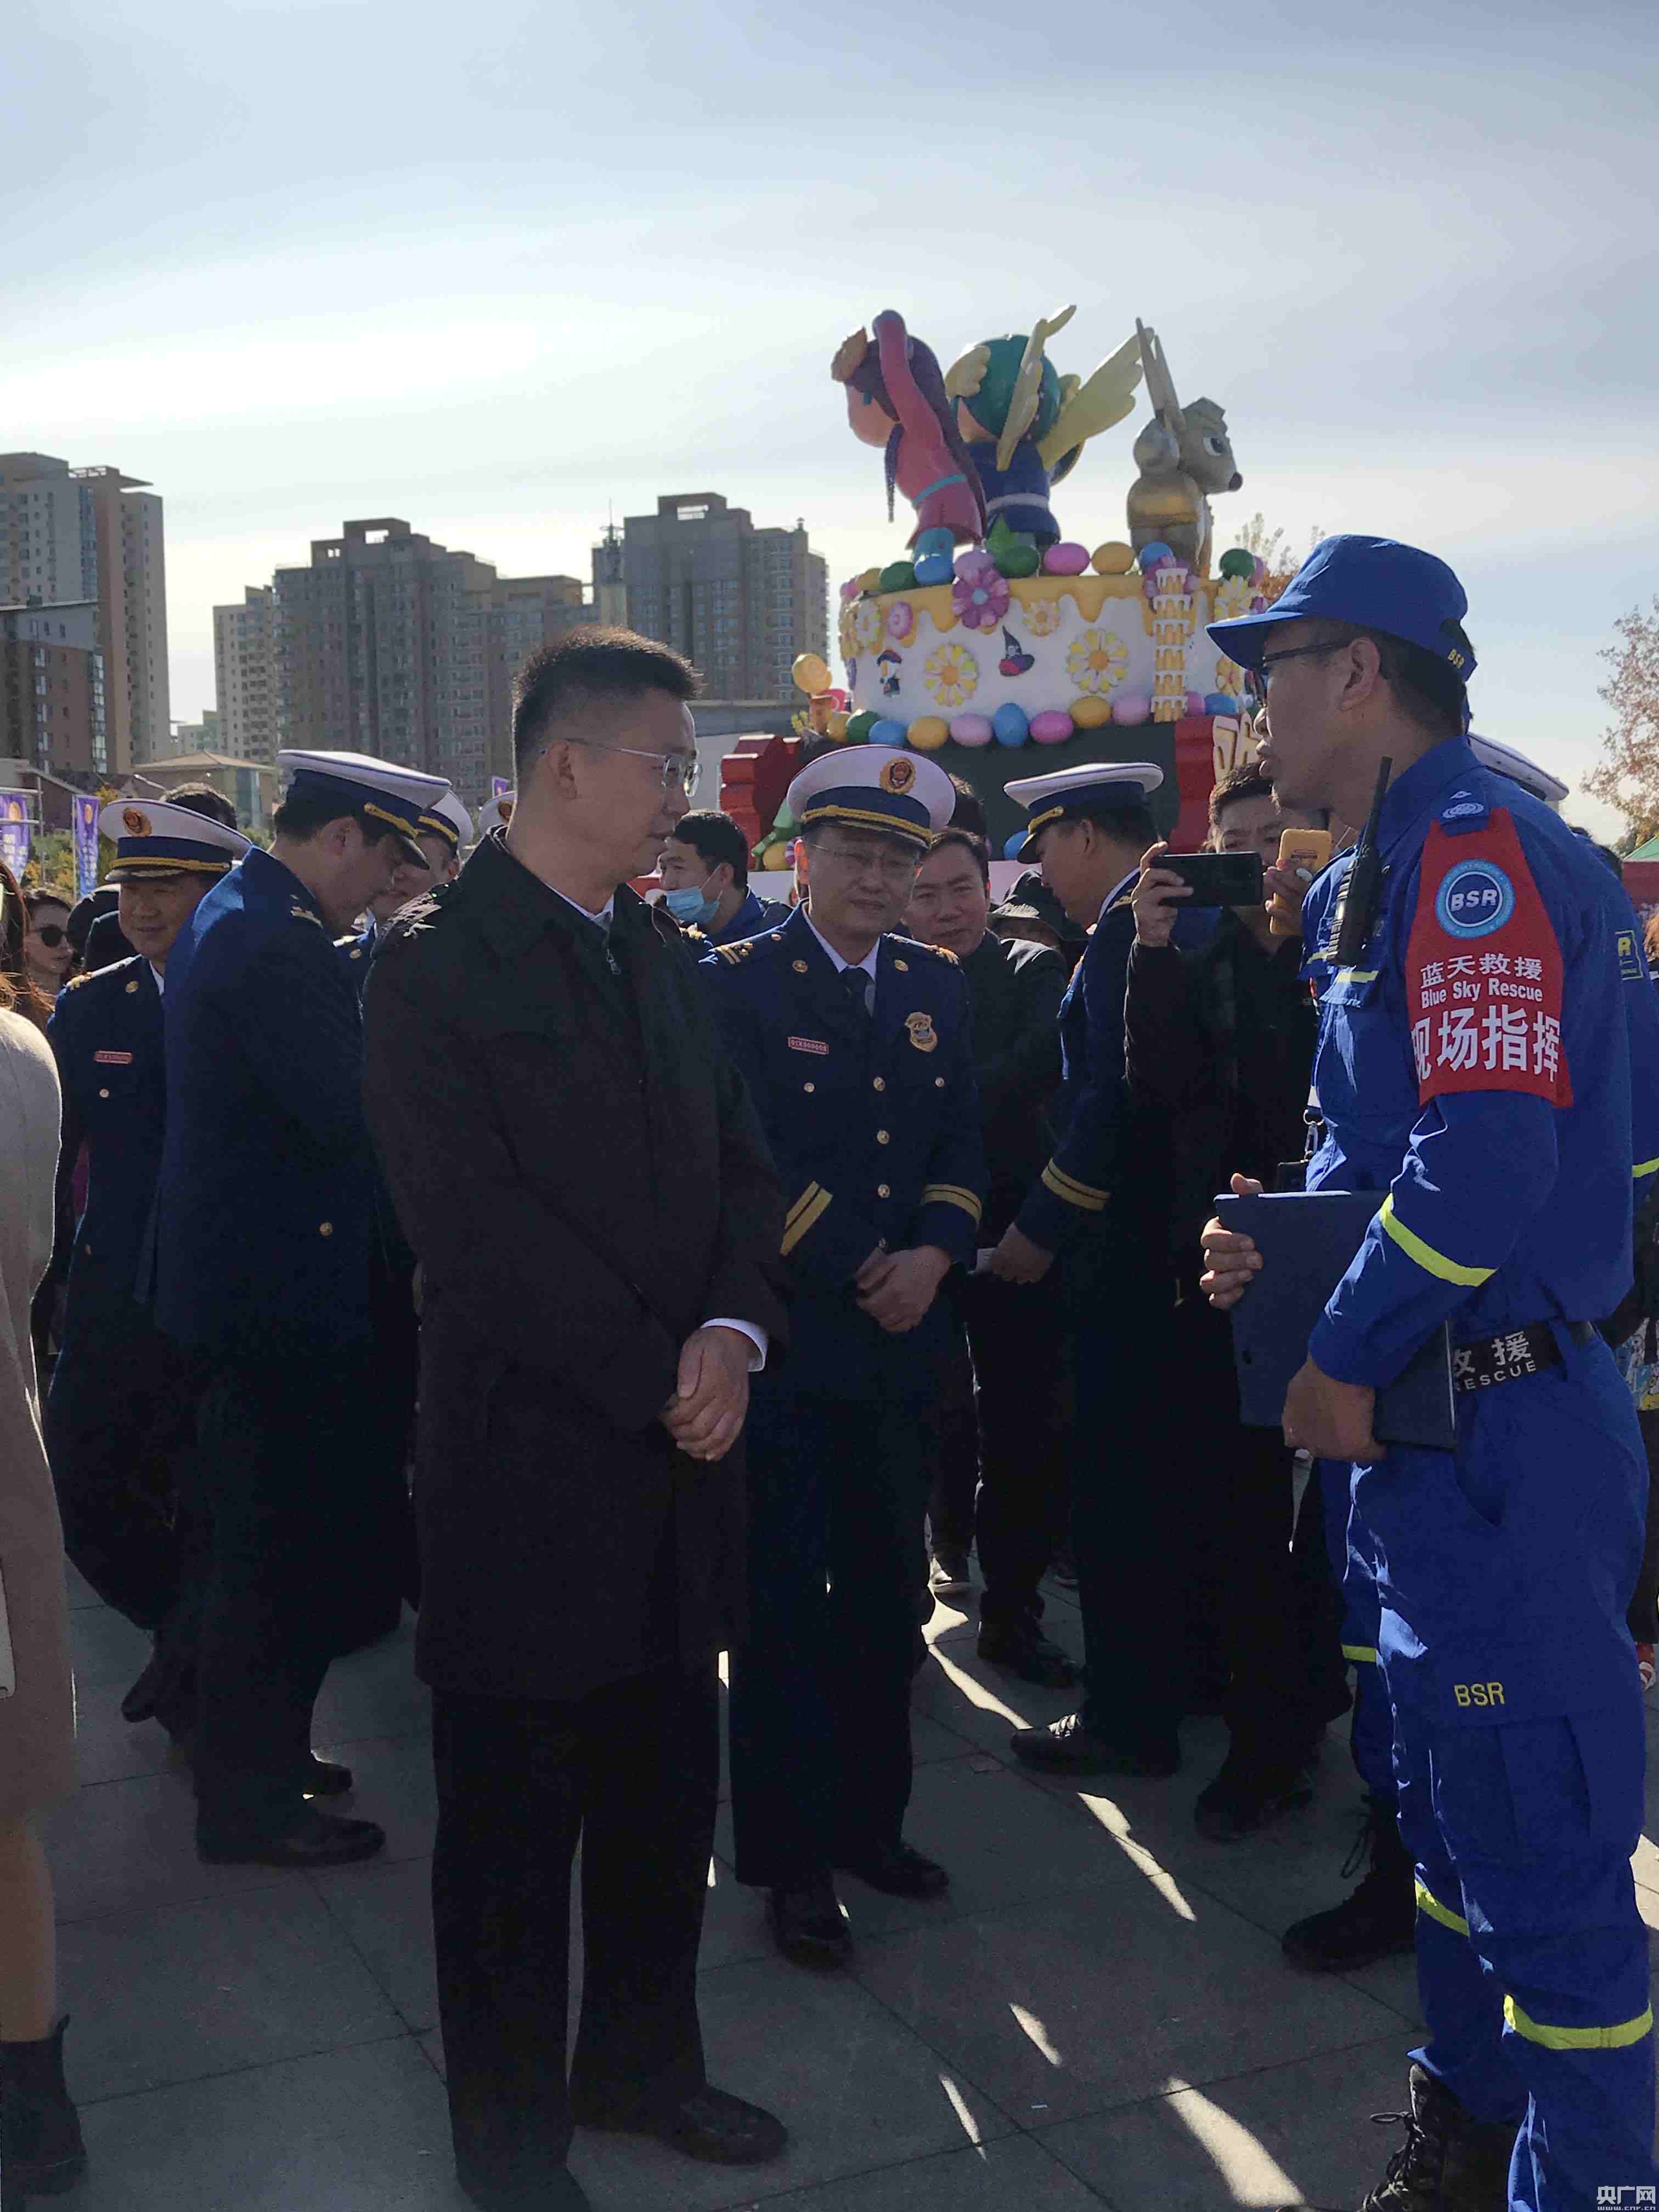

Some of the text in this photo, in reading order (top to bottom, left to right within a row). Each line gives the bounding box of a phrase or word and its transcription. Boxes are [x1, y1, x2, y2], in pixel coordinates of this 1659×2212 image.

[1451, 889, 1498, 912] BSR
[1420, 952, 1543, 989] 蓝天救援
[1421, 977, 1543, 1009] Blue Sky Rescue
[1454, 1681, 1505, 1706] BSR
